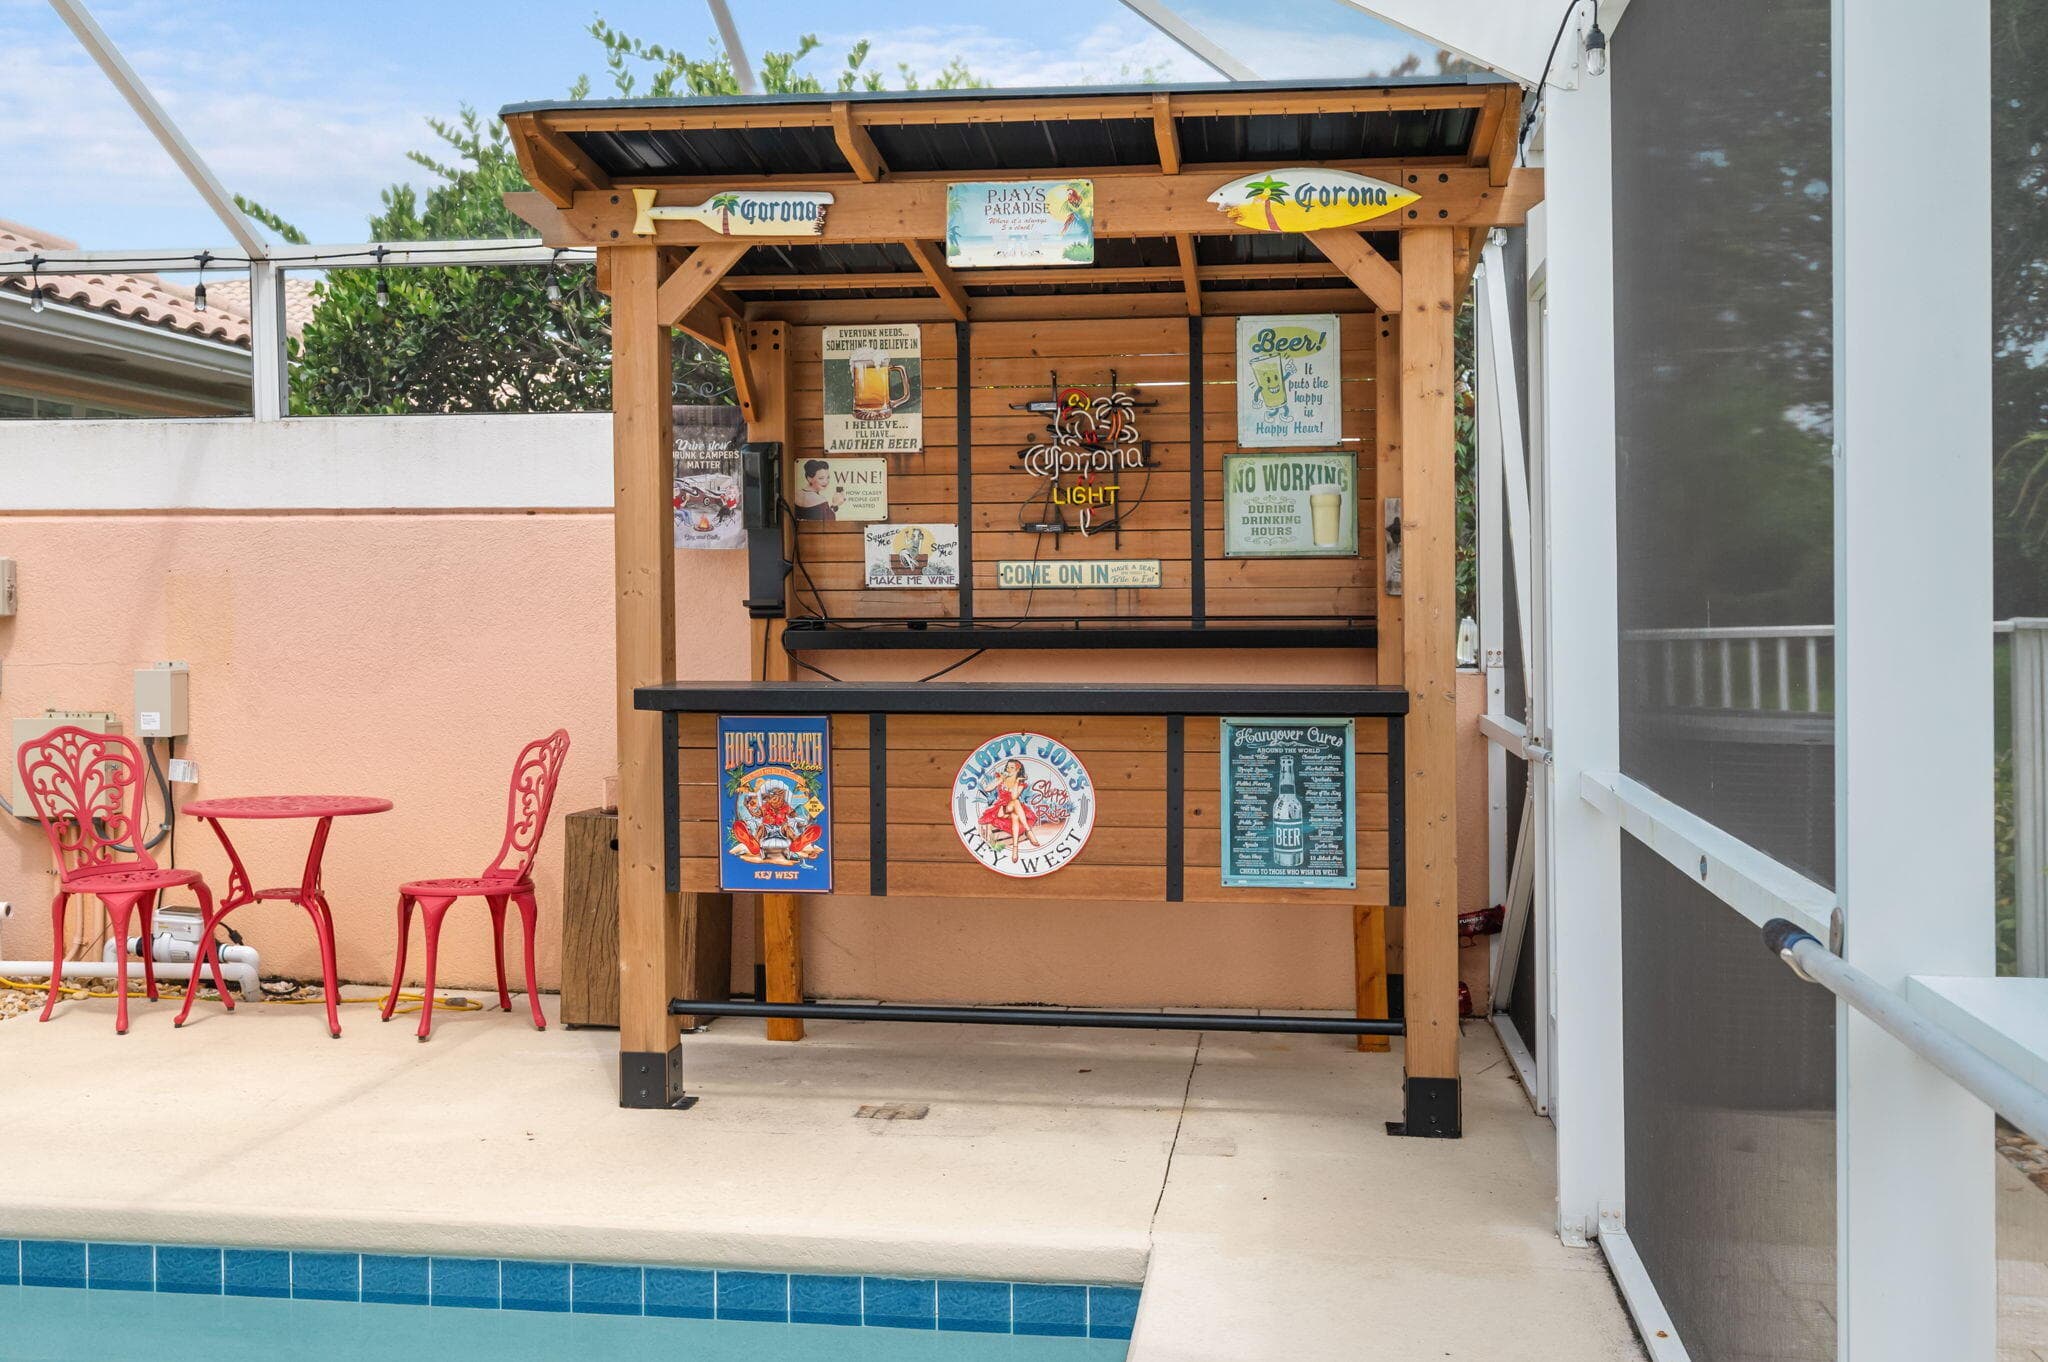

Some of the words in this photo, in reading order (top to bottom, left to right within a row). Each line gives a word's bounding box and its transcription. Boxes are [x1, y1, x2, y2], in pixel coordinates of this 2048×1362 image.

[987, 186, 1046, 203] PJAY'S
[1295, 182, 1388, 212] Corona
[740, 200, 818, 225] Corona
[984, 203, 1050, 216] PARADISE
[840, 328, 877, 338] EVERYONE
[826, 339, 867, 351] SOMETHING
[869, 339, 877, 350] TO
[880, 339, 908, 350] BELIEVE
[910, 338, 918, 349] IN
[1252, 328, 1327, 353] Beer!
[1304, 362, 1313, 375] It
[1288, 379, 1309, 392] puts
[1312, 376, 1328, 389] the
[1294, 391, 1322, 405] happy
[1304, 406, 1314, 417] in
[855, 430, 867, 438] I'LL
[1256, 422, 1288, 436] Happy
[1294, 422, 1323, 434] Hour!
[708, 440, 732, 451] slow
[830, 439, 884, 450] ANOTHER
[888, 438, 917, 449] BEER
[673, 450, 696, 459] RUNK
[700, 450, 740, 459] CAMPERS
[687, 460, 721, 469] MATTER
[1024, 444, 1144, 480] Corona
[833, 471, 883, 484] WINE!
[1232, 466, 1256, 493] NO
[1262, 463, 1348, 492] WORKING
[1053, 486, 1120, 505] LIGHT
[1248, 505, 1295, 514] DURING
[1242, 516, 1301, 525] DRINKING
[866, 528, 900, 543] Squeeze
[1251, 527, 1292, 536] HOURS
[930, 541, 957, 552] Stomp
[1003, 564, 1051, 584] COME
[1059, 564, 1082, 584] ON
[1091, 564, 1108, 584] IN
[1111, 564, 1129, 573] HAVE
[869, 576, 902, 585] MAKE
[907, 576, 922, 585] ME
[928, 576, 956, 585] WINE
[1234, 728, 1304, 747] Hangover
[1307, 727, 1343, 748] Cures
[724, 731, 766, 770] HOG'S
[768, 731, 823, 768] BREATH
[790, 760, 824, 772] Saloon
[959, 735, 1033, 790] SLOPPY
[1038, 740, 1090, 791] JOE'S
[1031, 779, 1069, 805] Sloppy
[1036, 804, 1071, 824] Rita
[1276, 827, 1301, 847] BEER
[963, 826, 1008, 867] KEY
[1020, 828, 1083, 873] WEST
[754, 870, 772, 880] KEY
[774, 870, 799, 880] WEST
[1286, 868, 1300, 876] WHO
